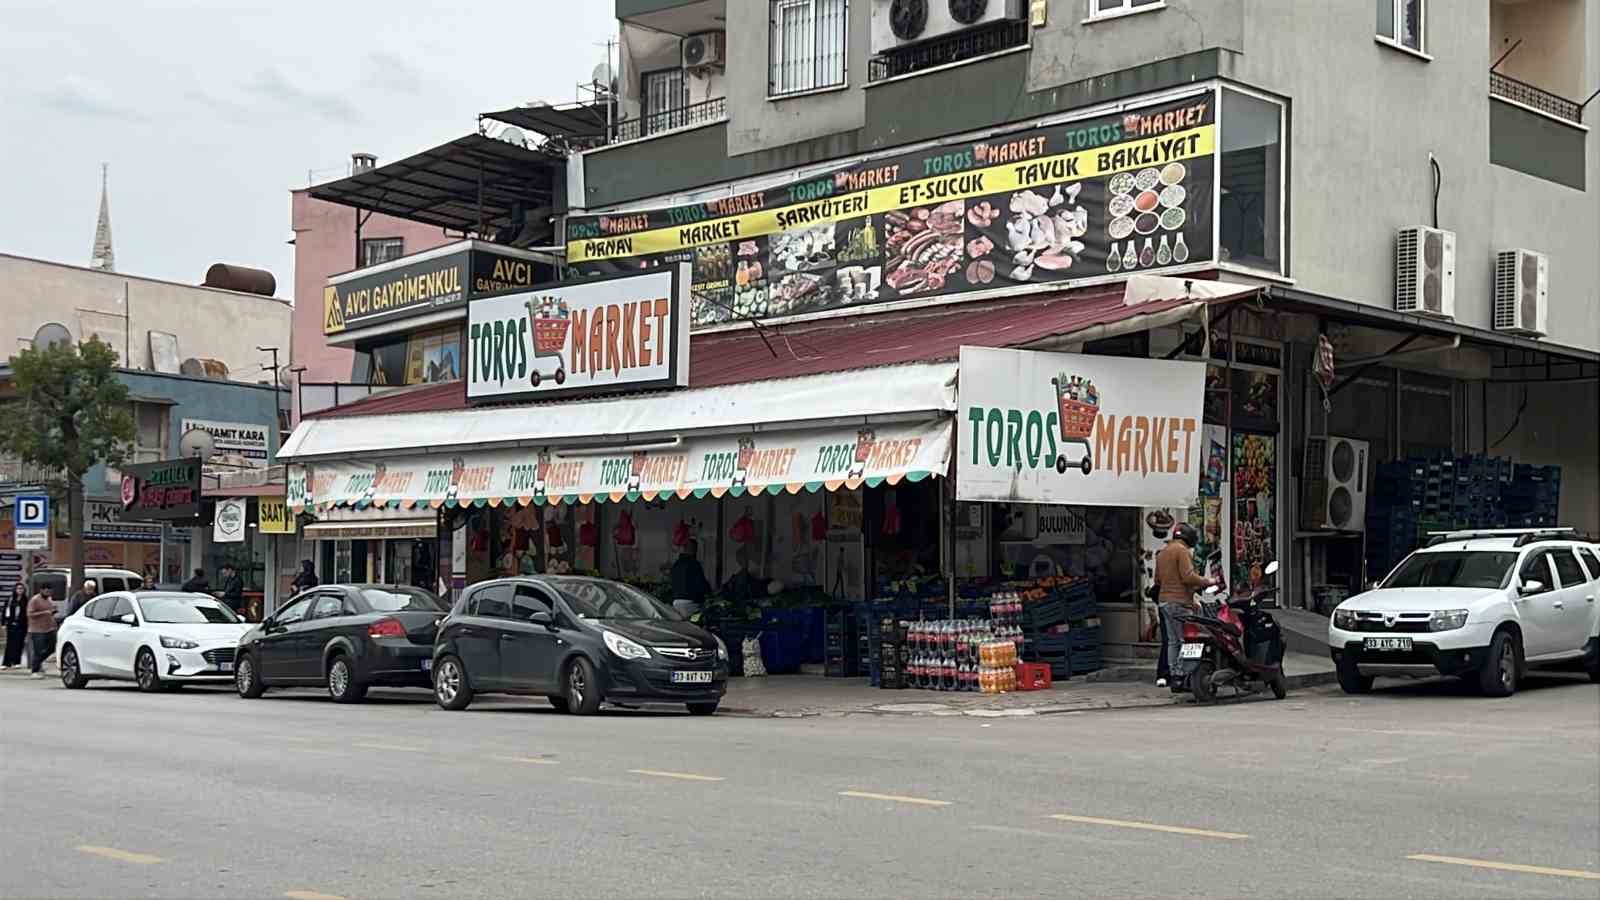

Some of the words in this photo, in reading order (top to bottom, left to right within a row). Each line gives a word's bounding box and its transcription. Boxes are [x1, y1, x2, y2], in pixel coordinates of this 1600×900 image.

[1066, 123, 1120, 150] TOROS
[1140, 104, 1207, 135] MARKET
[923, 150, 972, 175] TOROS
[988, 135, 1047, 162] MARKET
[584, 237, 633, 257] MANAV
[679, 219, 741, 246] MARKET
[776, 194, 869, 232] ŞARKÜTERİ
[899, 173, 984, 204] ET-SUCUK
[1015, 156, 1080, 185] TAVUK
[1096, 133, 1201, 173] BAKLİYAT
[788, 179, 834, 200] TOROS
[848, 165, 899, 190] MARKET
[608, 214, 649, 233] MARKET
[666, 205, 707, 223] TOROS
[719, 192, 765, 214] MARKET
[492, 259, 532, 286] AVCI
[345, 288, 371, 317] AVCI
[372, 266, 462, 311] GAYRİMENKUL
[469, 316, 528, 388] TOROS
[570, 298, 669, 380] MARKET
[239, 429, 265, 441] KARA
[968, 406, 1058, 475] TOROS
[1094, 413, 1197, 479] MARKET
[600, 459, 632, 485] TOROS
[640, 455, 687, 487] MARKET
[702, 452, 737, 480] TOROS
[747, 448, 798, 480] MARKET
[814, 444, 856, 473] TOROS
[864, 438, 922, 470] MARKET
[508, 465, 537, 490] TOROS
[545, 461, 584, 489] MARKET
[25, 502, 39, 520] D
